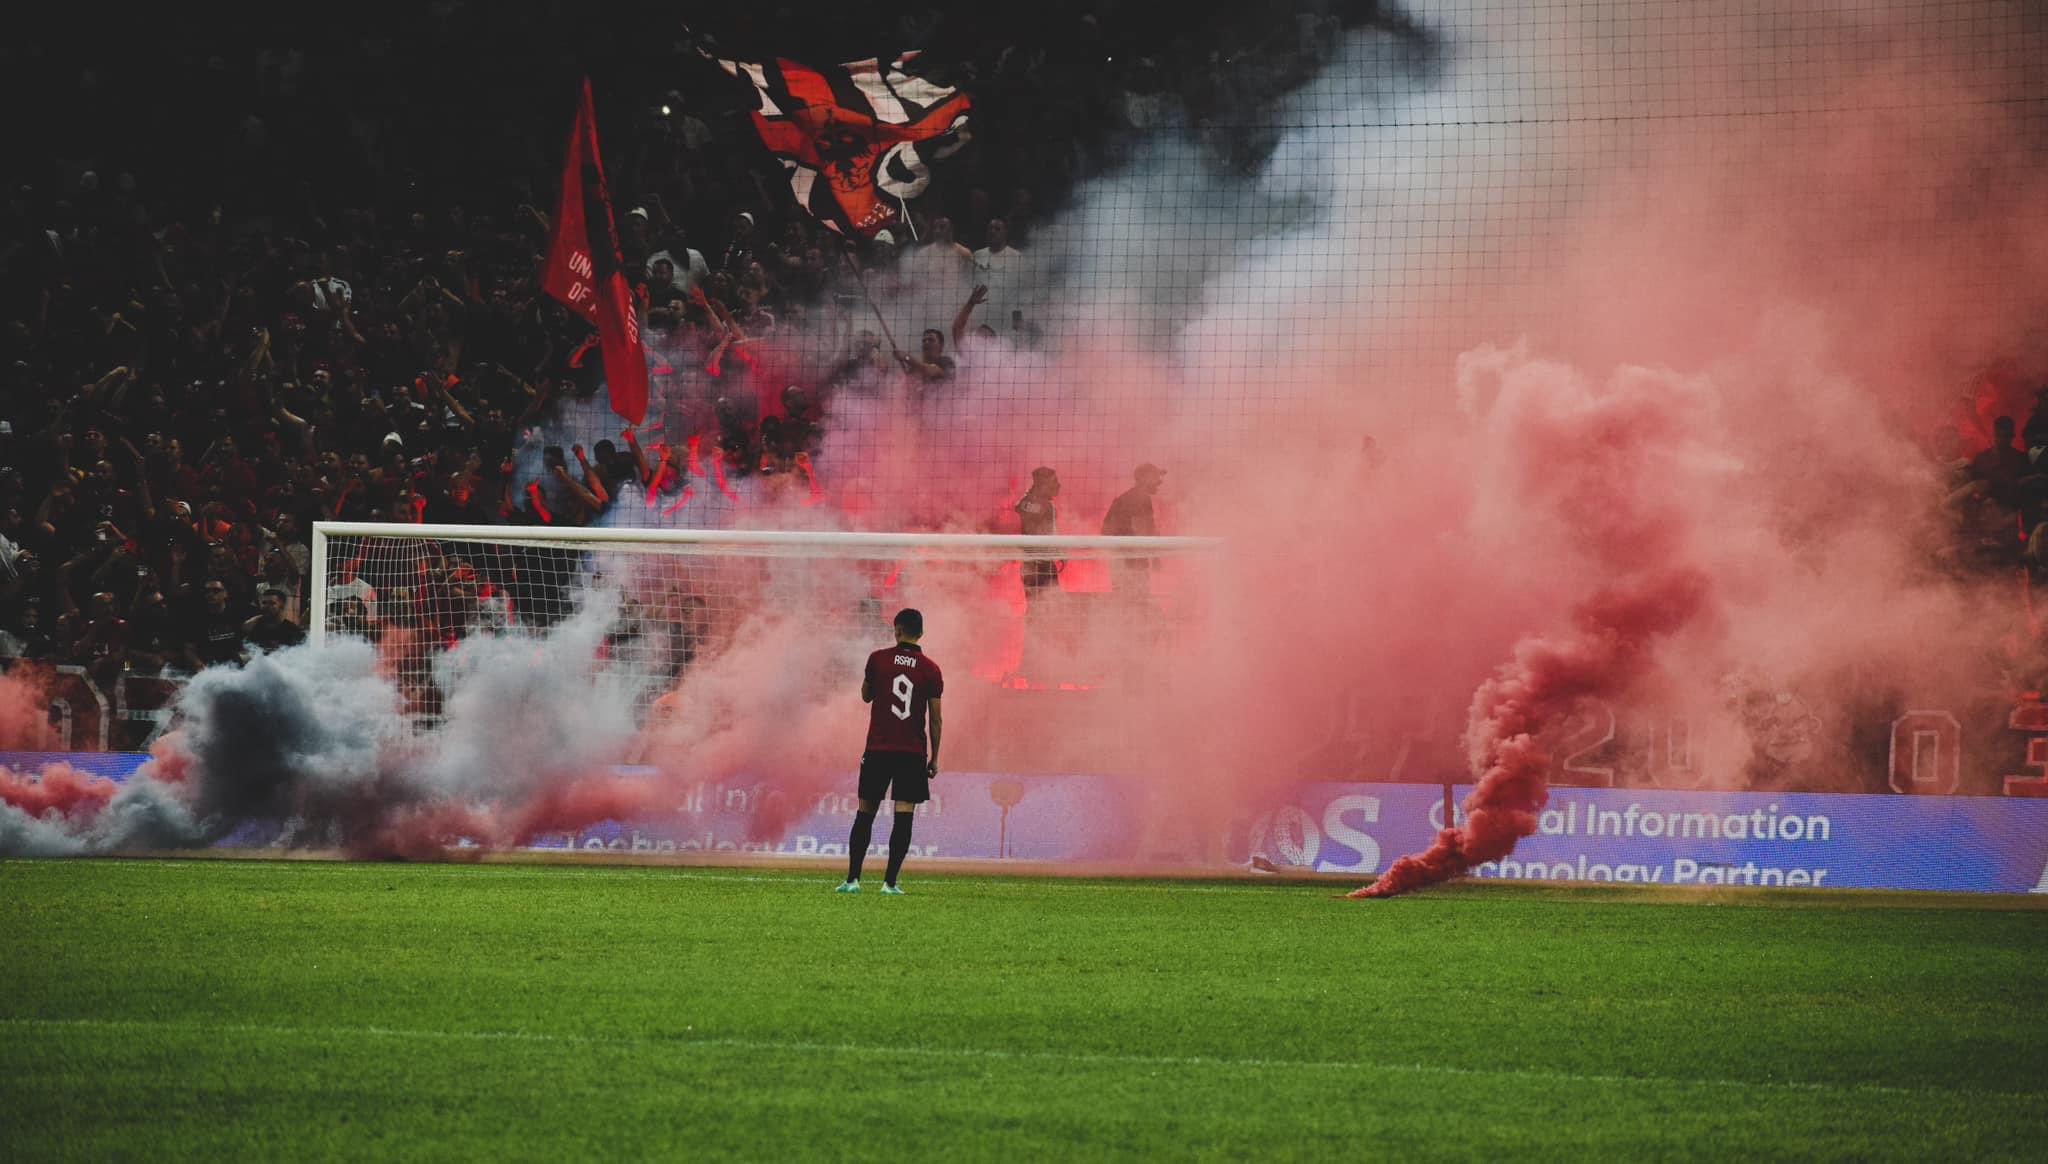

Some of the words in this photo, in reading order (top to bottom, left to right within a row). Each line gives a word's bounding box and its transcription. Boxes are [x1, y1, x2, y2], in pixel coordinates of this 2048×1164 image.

[891, 673, 914, 720] 9
[1587, 803, 1830, 840] Information
[1673, 859, 1827, 887] Partner
